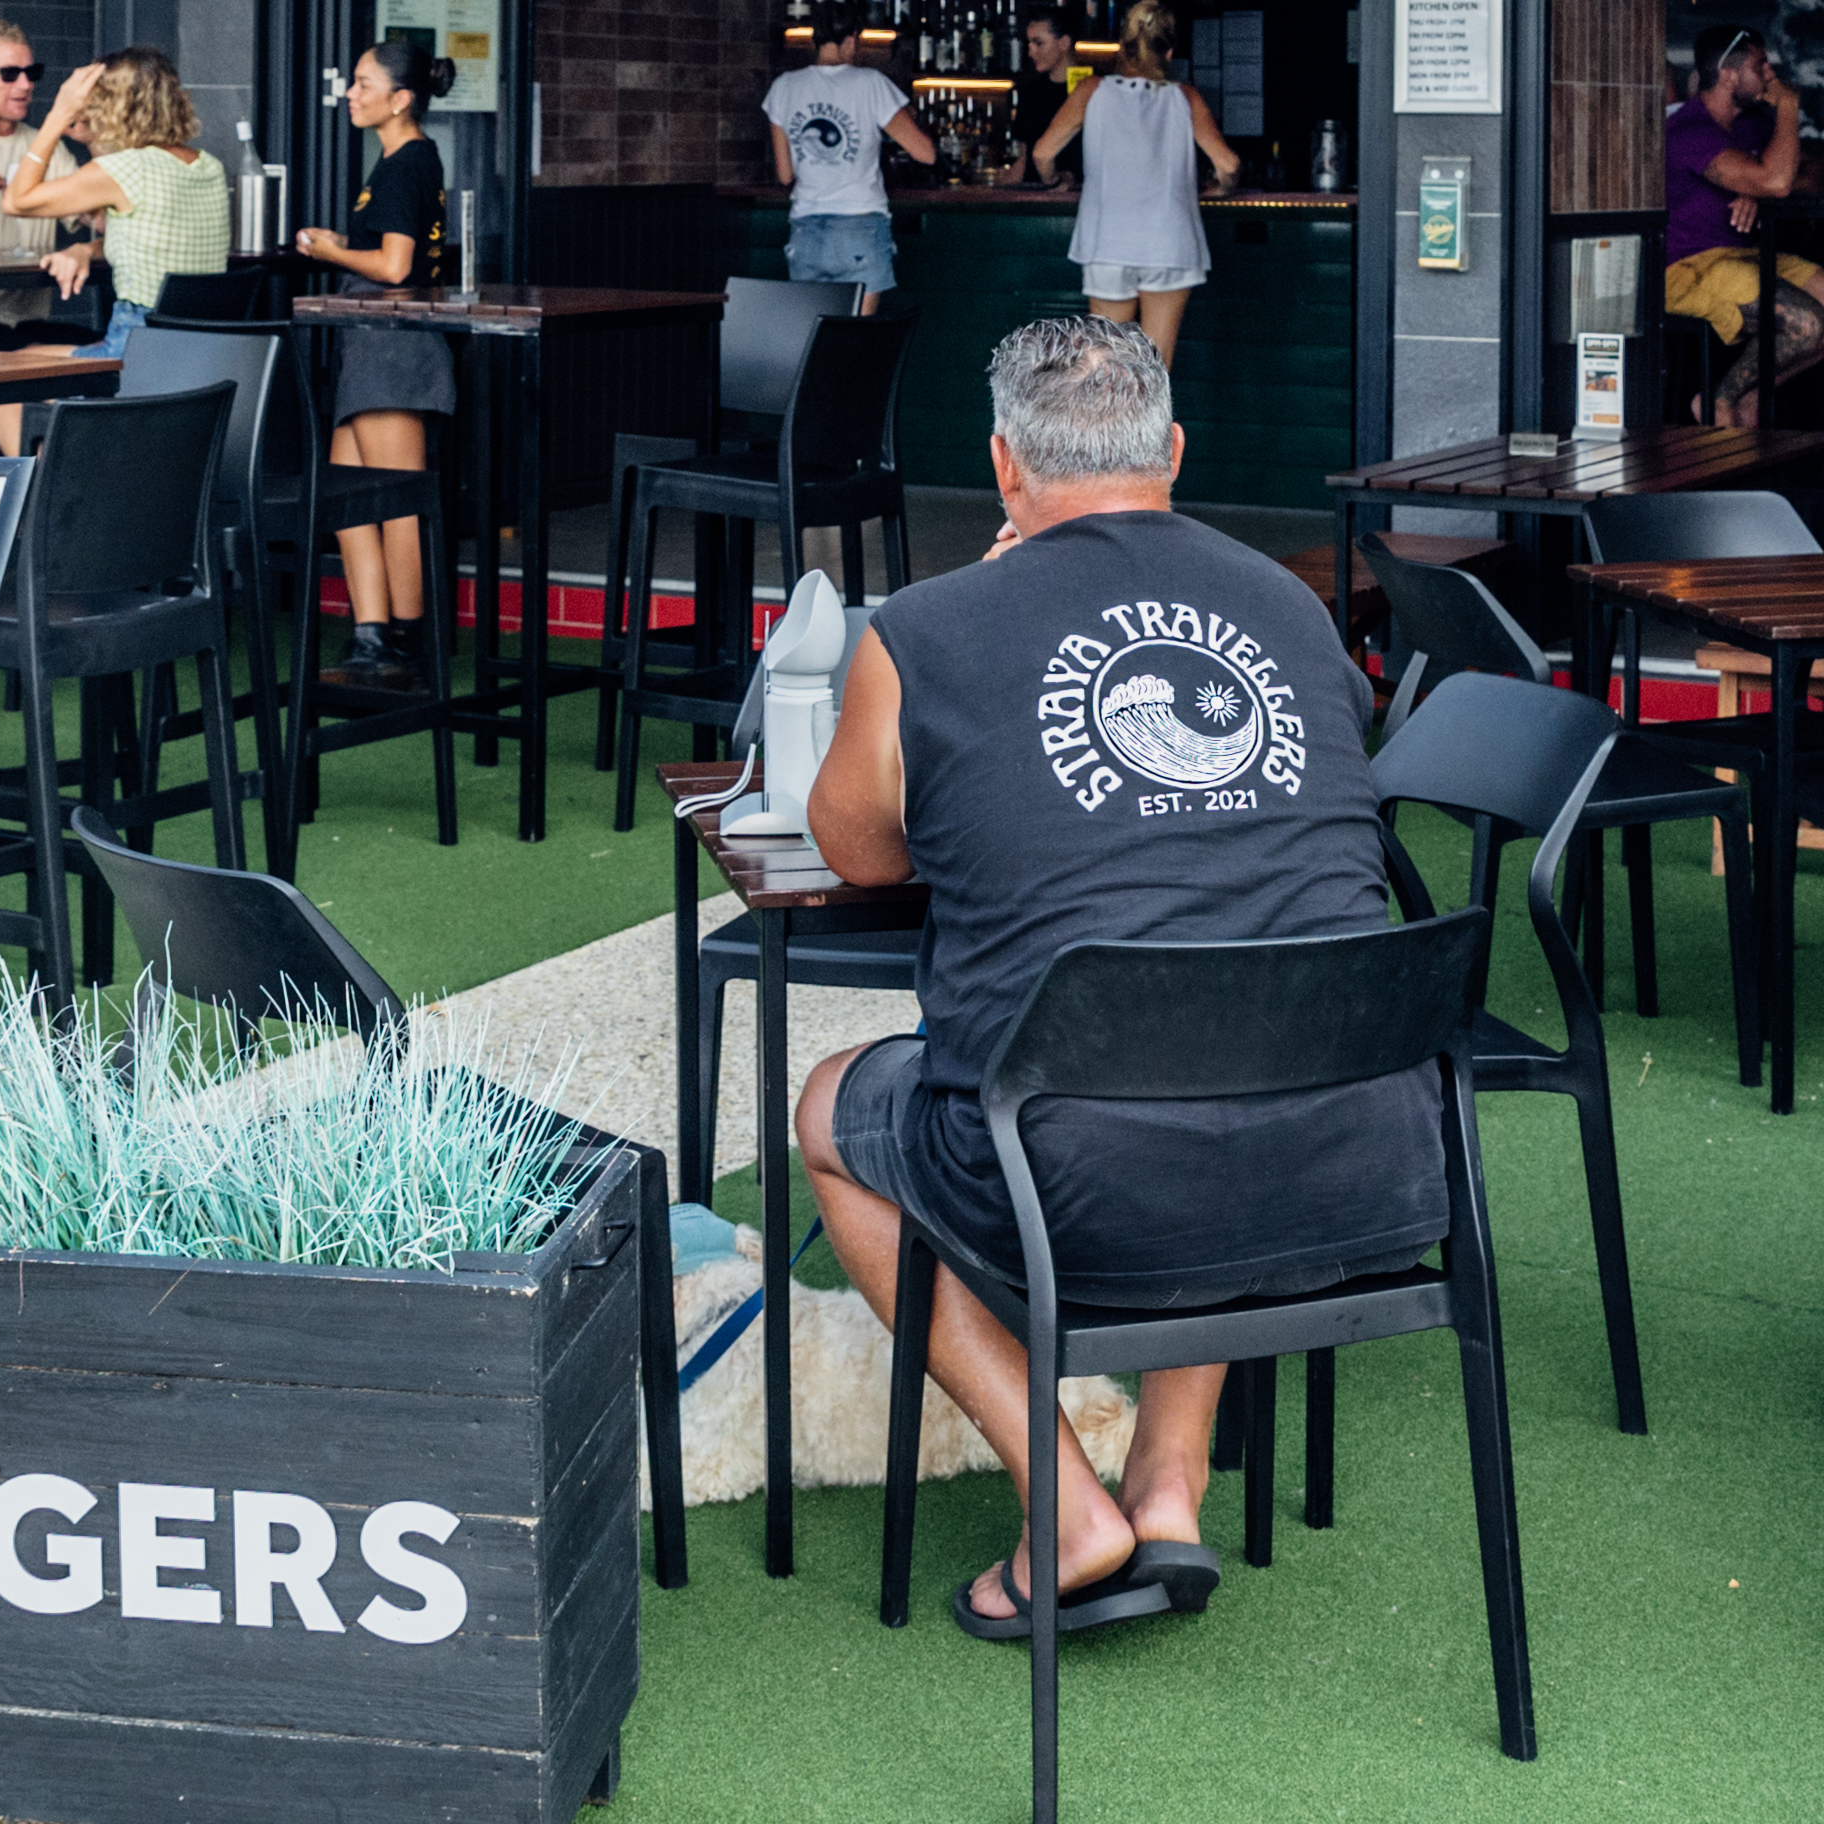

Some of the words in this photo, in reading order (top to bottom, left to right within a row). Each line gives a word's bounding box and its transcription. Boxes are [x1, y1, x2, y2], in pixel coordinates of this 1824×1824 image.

[1409, 2, 1449, 11] KITCHEN
[1037, 633, 1124, 813] STRAYA
[1101, 601, 1307, 797] TRAVELLERS
[1138, 790, 1193, 817] EST.
[1204, 788, 1258, 812] 2021
